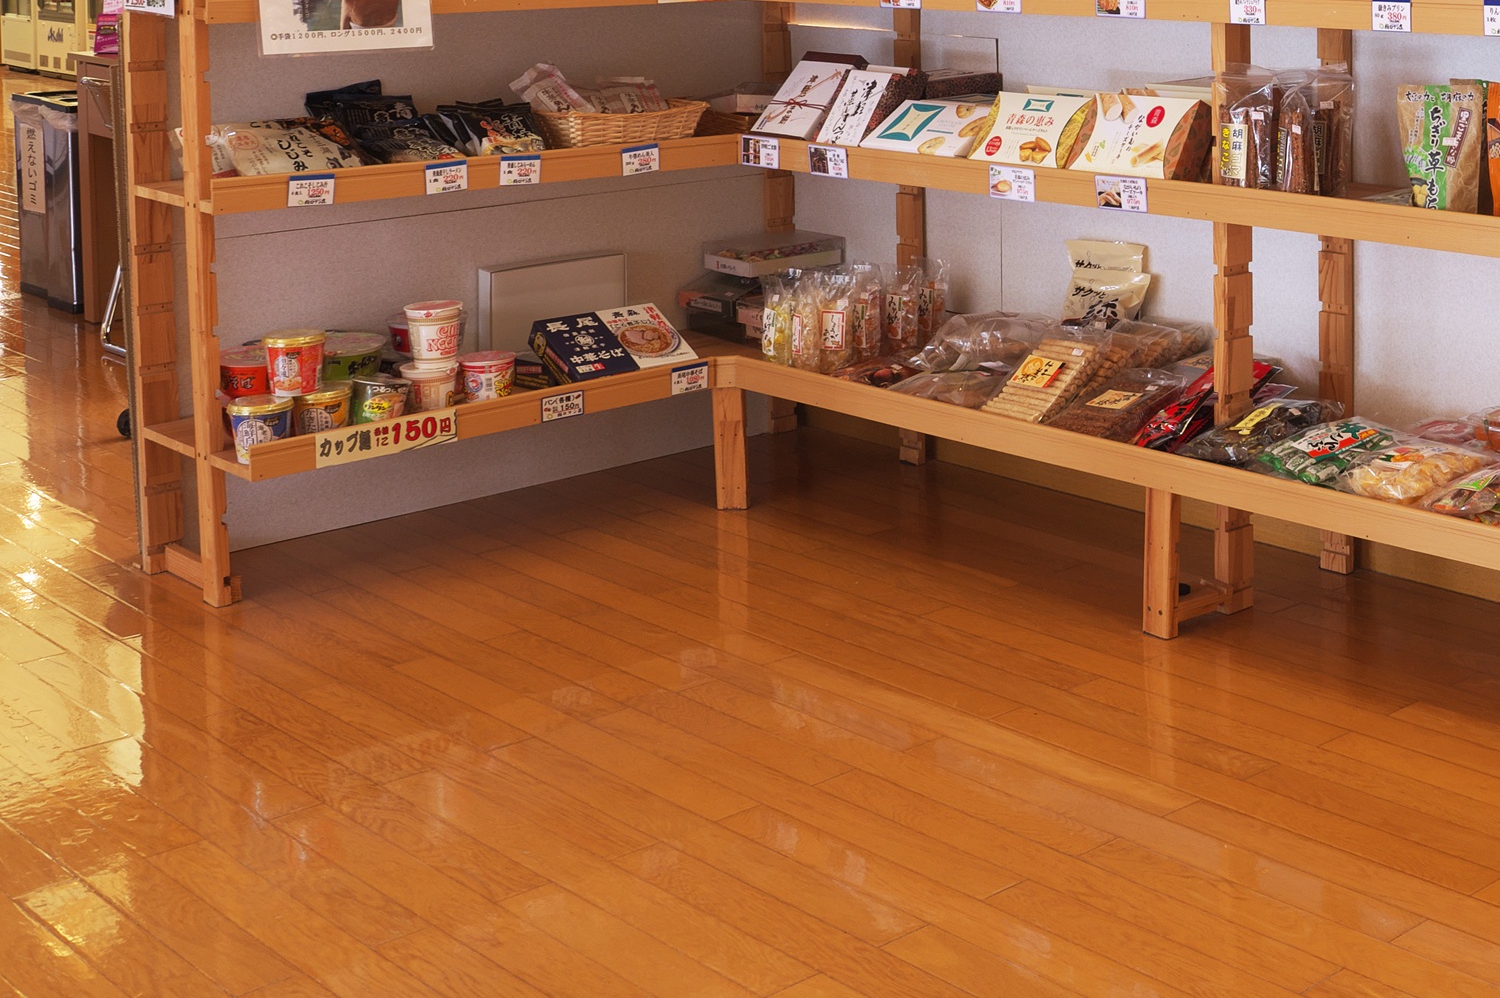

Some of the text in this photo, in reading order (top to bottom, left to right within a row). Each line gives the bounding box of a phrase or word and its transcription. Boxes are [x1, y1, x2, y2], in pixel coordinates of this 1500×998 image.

[1006, 113, 1054, 127] 青森の恵み
[25, 127, 40, 206] 燃えないゴミ
[546, 316, 599, 332] 長尾
[570, 347, 625, 364] 中華そば
[319, 416, 451, 457] カップ麺 150円
